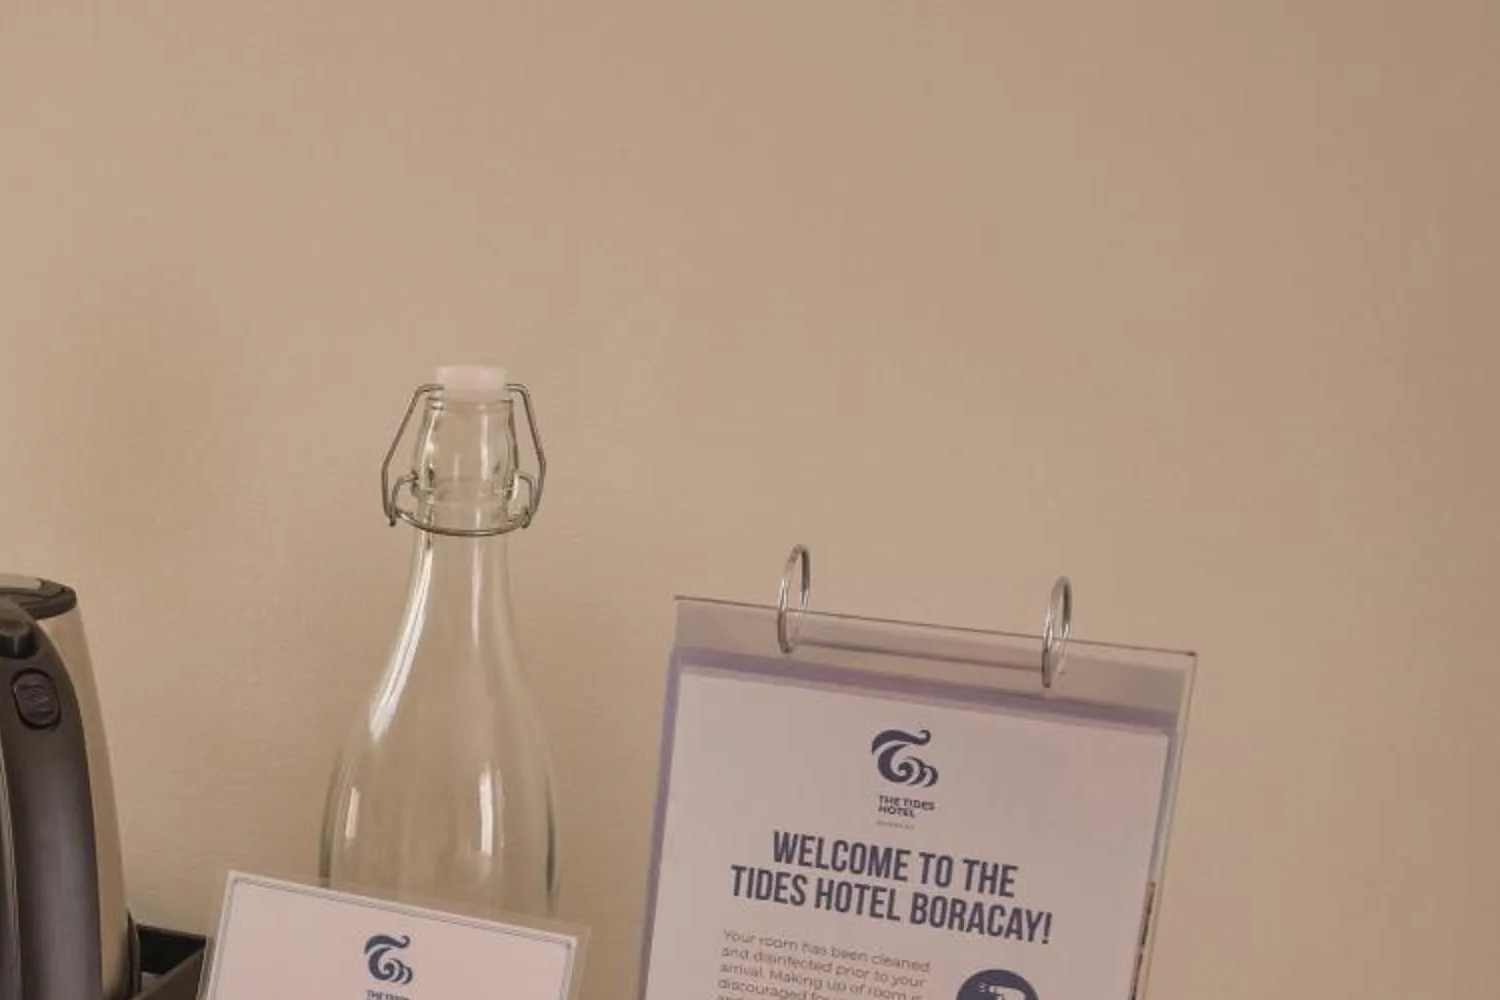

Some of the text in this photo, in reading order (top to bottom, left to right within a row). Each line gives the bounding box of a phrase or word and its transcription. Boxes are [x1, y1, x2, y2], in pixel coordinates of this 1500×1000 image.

[773, 830, 1018, 898] WELCOME TO THE
[730, 863, 1052, 944] TIDES HOTEL BORACAY!
[721, 946, 927, 988] and disinfected prior to your
[723, 929, 930, 973] Your room has been cleaned
[768, 968, 823, 991] Making
[826, 980, 846, 992] up
[848, 983, 866, 994] of
